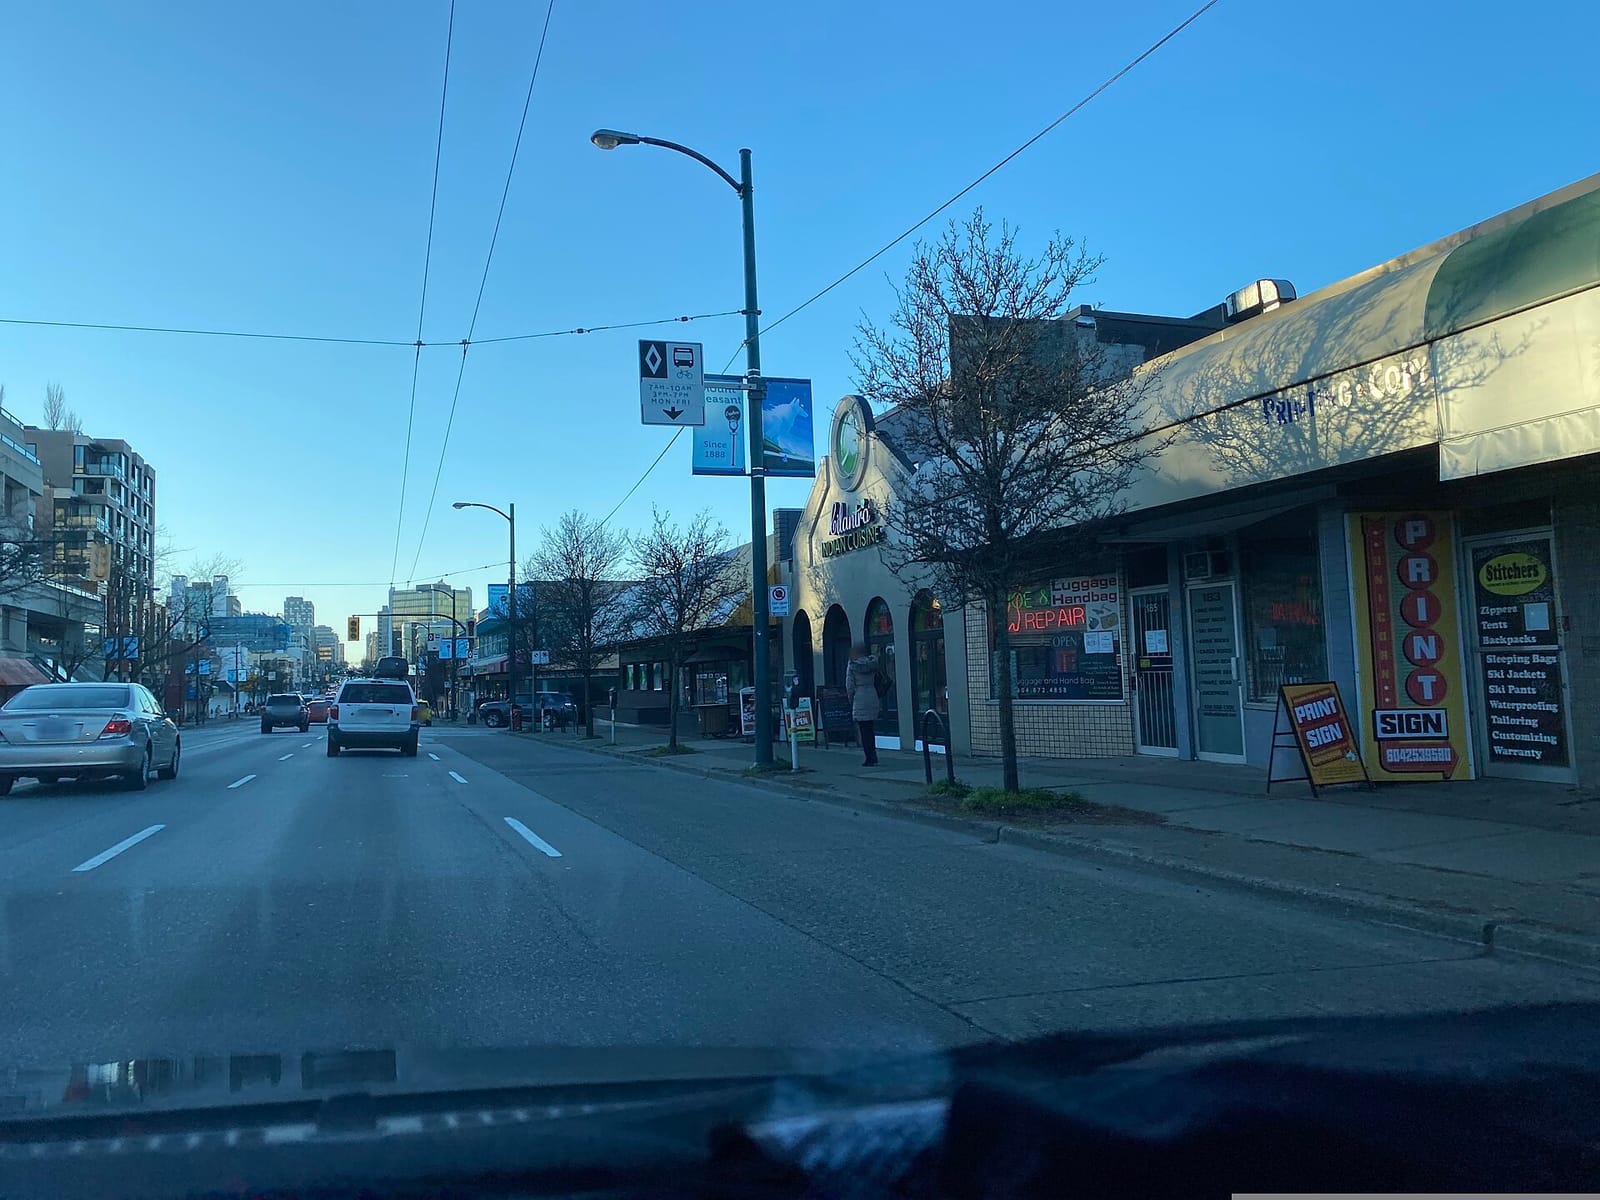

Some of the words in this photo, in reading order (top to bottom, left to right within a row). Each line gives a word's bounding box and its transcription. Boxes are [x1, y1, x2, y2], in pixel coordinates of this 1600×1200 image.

[705, 395, 742, 404] easant
[703, 440, 727, 449] Since
[846, 526, 881, 551] CUISINE
[1486, 562, 1539, 582] Stitchers
[1052, 577, 1118, 592] Luggage
[1052, 592, 1118, 605] Handbag
[1203, 592, 1221, 602] 183
[1405, 521, 1437, 700] PRINT
[1480, 606, 1518, 616] Zippers
[1024, 607, 1086, 630] REPAIR
[1481, 621, 1508, 630] Tents
[1052, 635, 1078, 649] OPEN
[1482, 635, 1537, 646] Backpacks
[1486, 654, 1531, 665] Sleeping
[1532, 654, 1558, 665] Bags
[1043, 677, 1059, 685] and
[1060, 676, 1079, 685] Hand
[1487, 669, 1505, 679] Ski
[1506, 669, 1547, 679] Jackets
[1488, 684, 1506, 694] Ski
[1507, 684, 1537, 695] Pants
[1294, 697, 1337, 724] PRINT
[1489, 700, 1559, 713] Waterproofing
[1380, 713, 1442, 734] SIGN
[1490, 715, 1539, 728] Tailoring
[1305, 722, 1344, 748] SIGN
[1491, 730, 1558, 745] Customizing
[1492, 745, 1543, 760] Warranty
